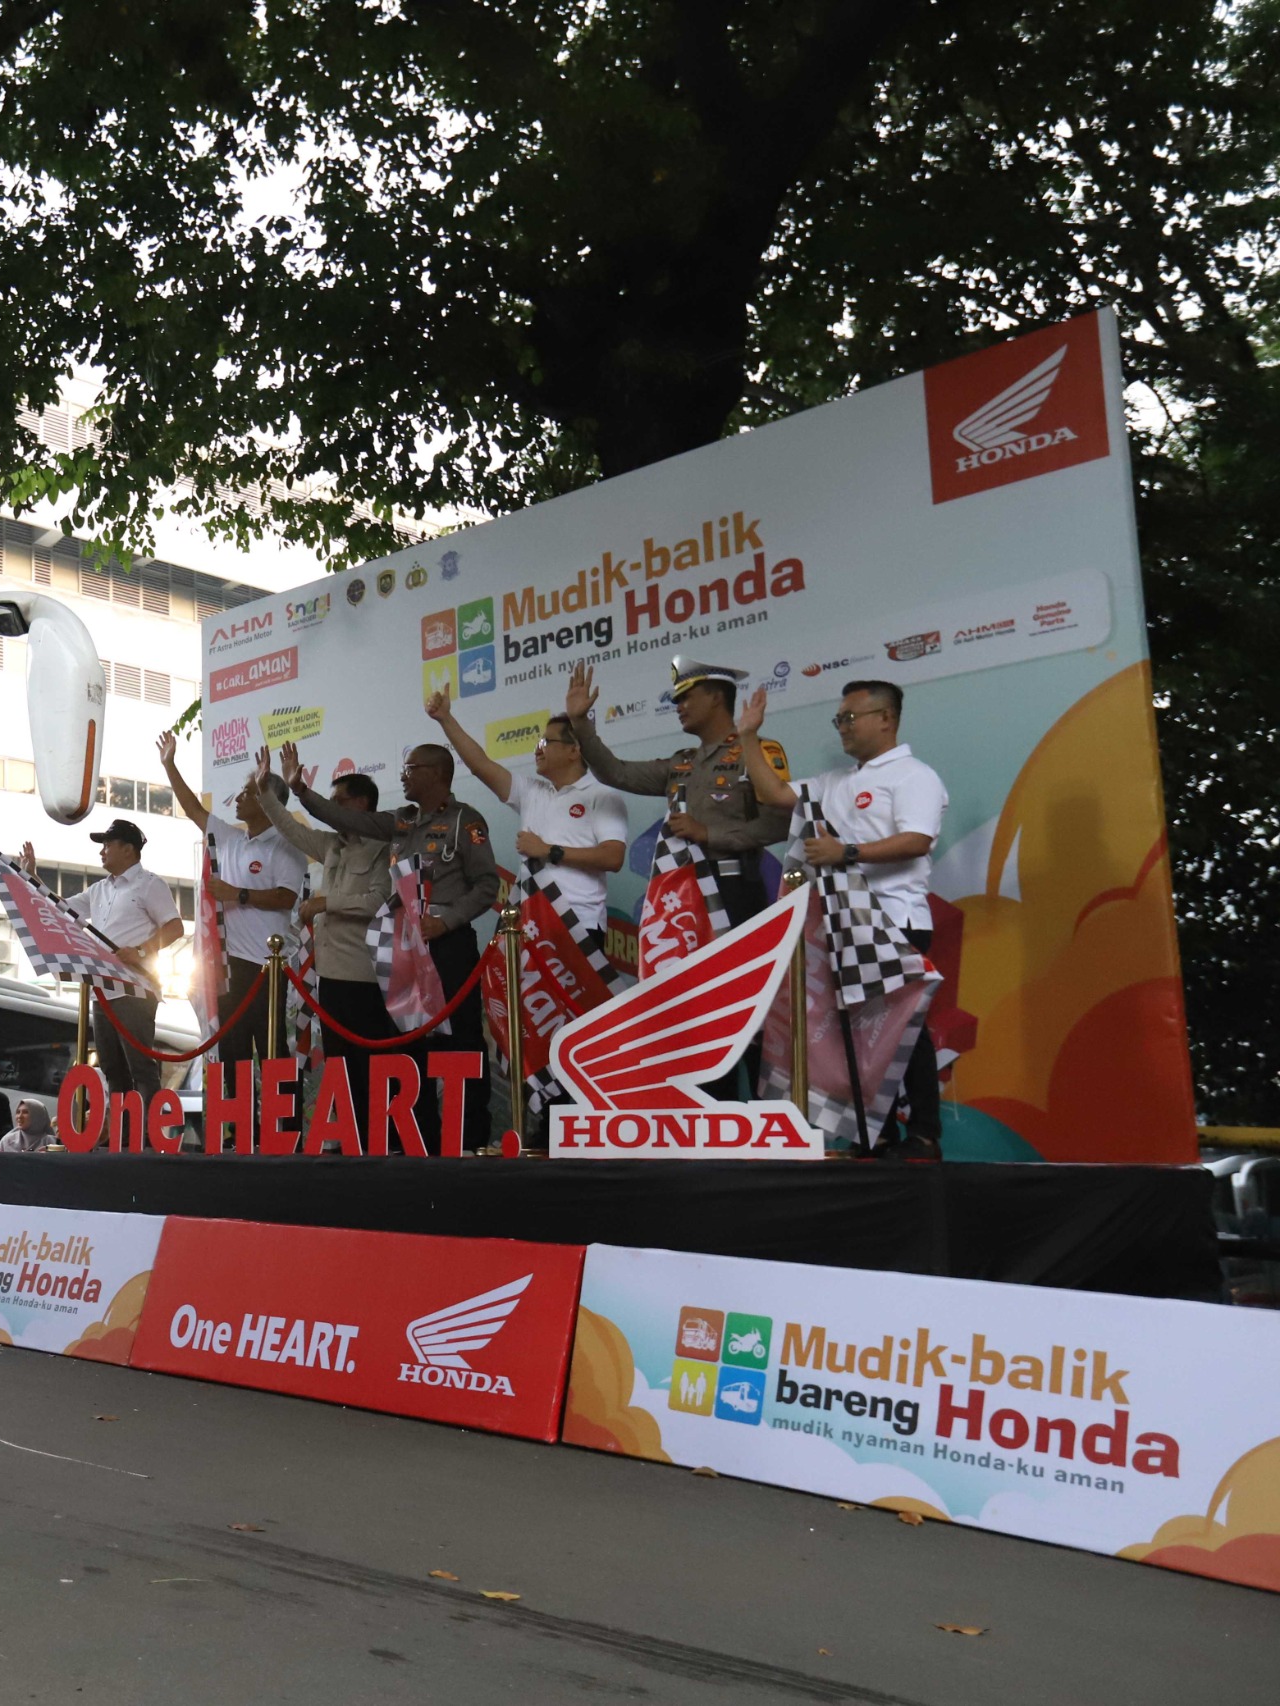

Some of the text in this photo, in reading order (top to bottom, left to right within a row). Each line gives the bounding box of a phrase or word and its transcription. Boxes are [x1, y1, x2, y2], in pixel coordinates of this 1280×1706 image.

[955, 426, 1078, 473] HONDA
[503, 511, 764, 632] Mudik-balik
[504, 552, 806, 664] bareng Honda
[1036, 601, 1067, 612] Honda
[1040, 617, 1065, 628] Parts
[210, 611, 273, 646] AHM
[217, 642, 232, 653] Astra
[233, 636, 252, 648] Honda
[254, 630, 273, 640] Motor
[505, 609, 768, 686] mudik nyaman Honda-ku aman
[822, 658, 849, 671] NSC
[626, 700, 647, 714] MCF
[267, 719, 293, 731] SELAMAT
[267, 728, 291, 739] MUDIK
[496, 724, 541, 743] ADIRA
[57, 1064, 185, 1154] One
[559, 1113, 810, 1149] HONDA
[17, 1261, 102, 1304] Honda
[12, 1295, 52, 1311] Honda-ku
[54, 1304, 78, 1314] aman
[170, 1304, 359, 1374] One HEART.
[397, 1363, 515, 1397] HONDA
[780, 1322, 1130, 1405] Mudik-balik
[776, 1369, 1180, 1479] bareng Honda
[772, 1414, 1125, 1494] mudik nyaman Honda-ku aman
